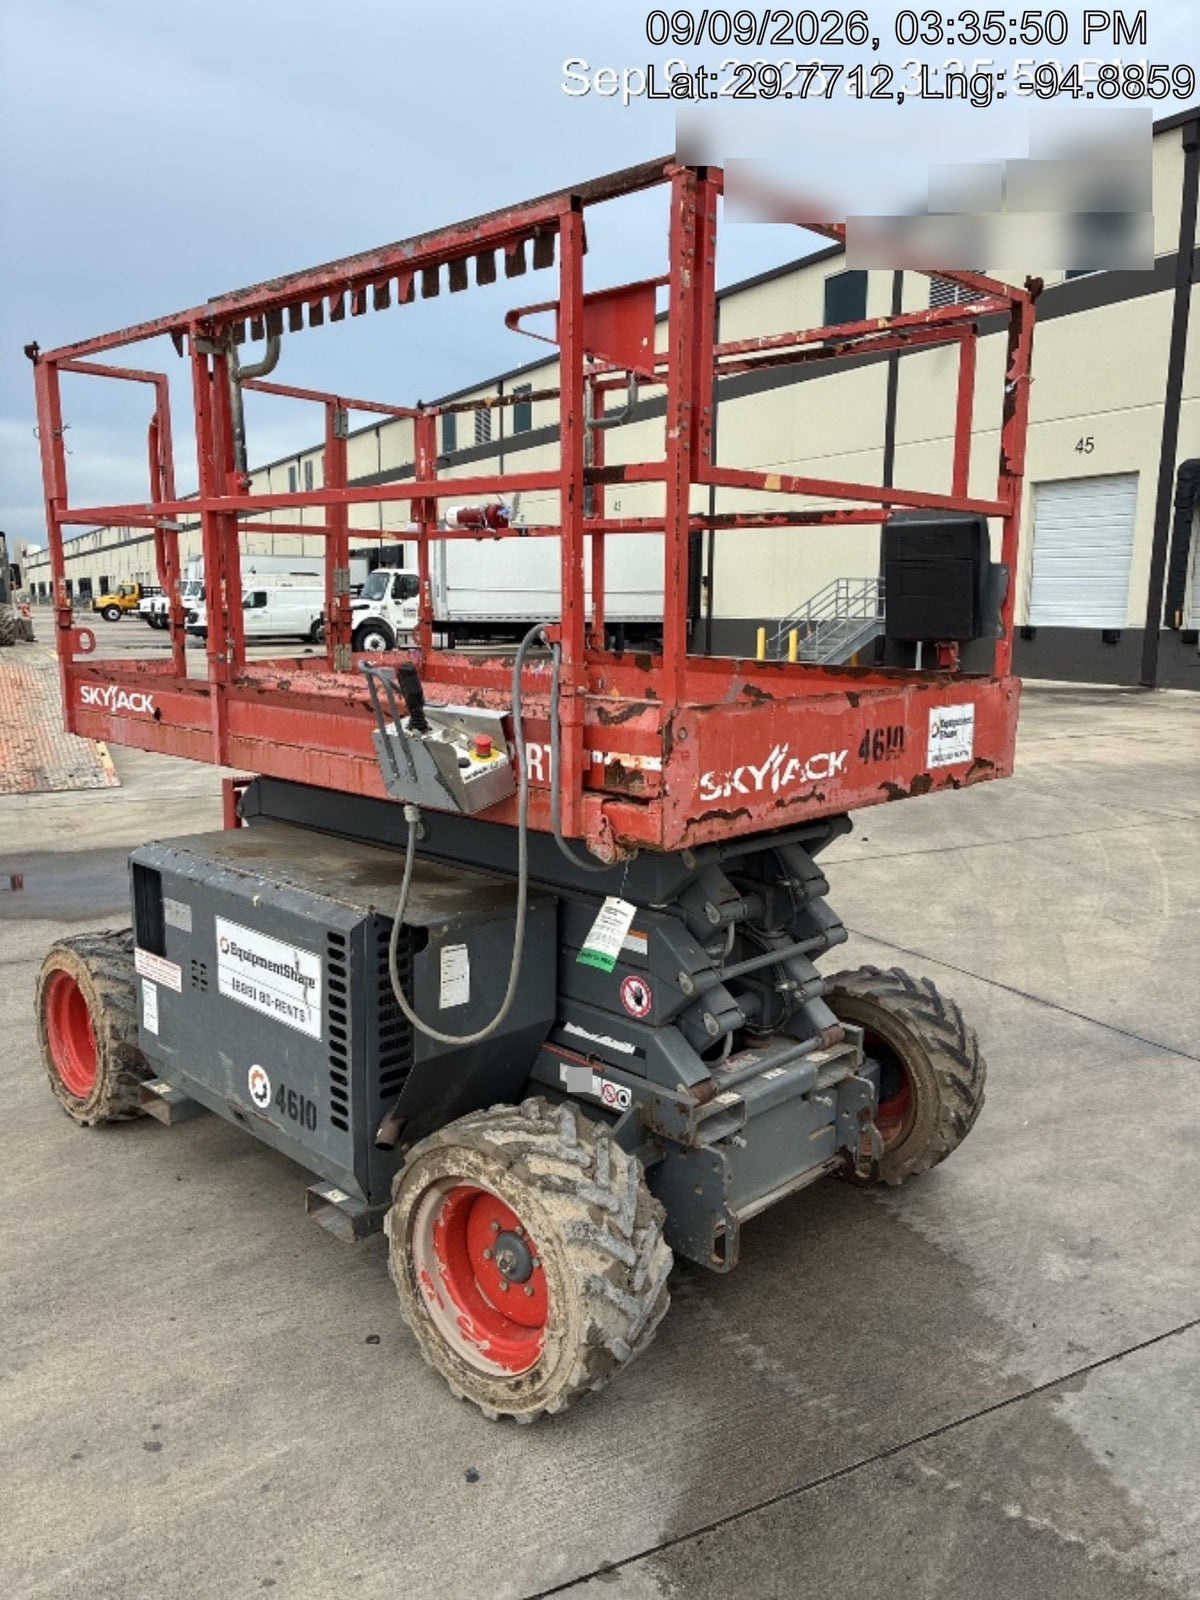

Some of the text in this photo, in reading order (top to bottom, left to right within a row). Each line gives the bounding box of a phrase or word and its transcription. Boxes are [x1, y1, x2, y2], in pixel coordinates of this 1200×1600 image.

[1075, 436, 1095, 454] 45
[80, 684, 155, 714] SKYJACK
[858, 725, 905, 764] 4610
[699, 743, 849, 801] SKYJACK
[230, 941, 316, 989] EquipmentShare
[275, 1083, 318, 1133] 4610
